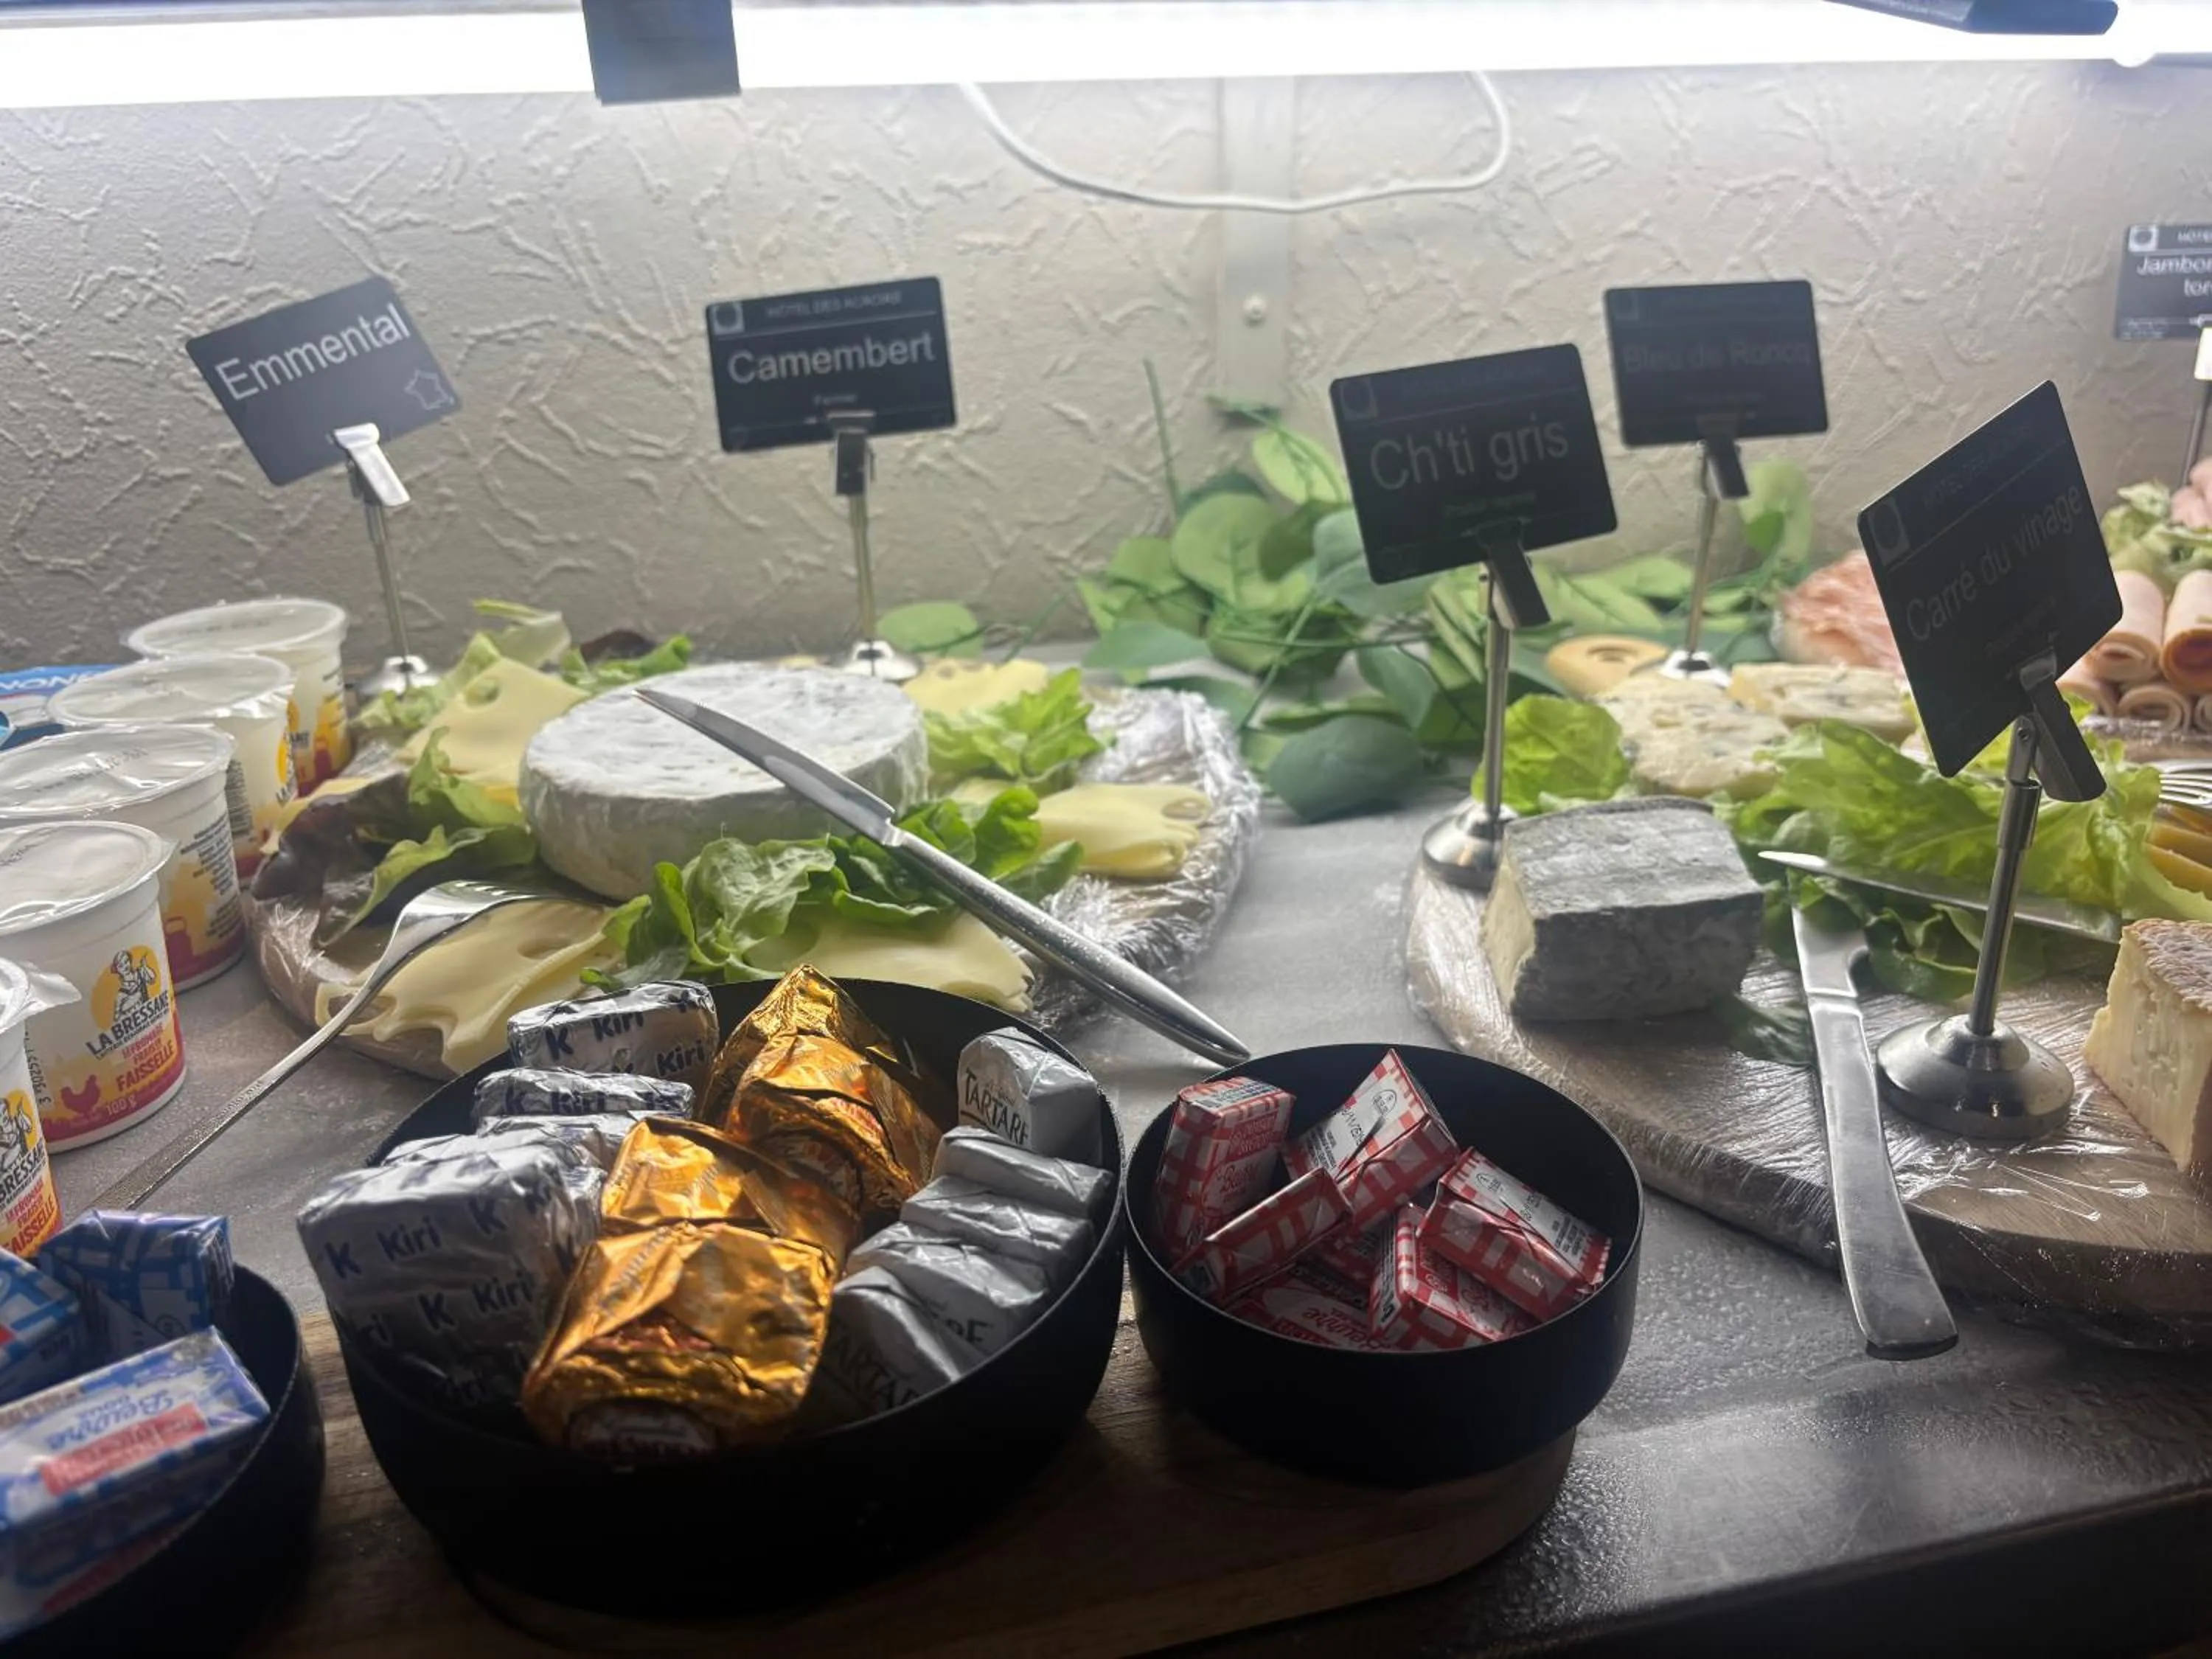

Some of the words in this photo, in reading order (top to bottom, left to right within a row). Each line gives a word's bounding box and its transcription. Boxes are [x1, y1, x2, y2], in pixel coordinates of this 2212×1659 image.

[215, 302, 411, 400] Emmental
[728, 332, 936, 384] Camembert
[1370, 422, 1475, 490] Ch'ti
[1489, 412, 1570, 481] gris
[1905, 560, 1979, 642] Carré
[1981, 542, 2012, 586] du
[2014, 484, 2084, 559] vinage
[86, 1033, 112, 1054] LA
[591, 1011, 644, 1041] Kiri
[116, 1040, 173, 1092] FAISSELLE
[656, 1040, 705, 1077] Kiri
[106, 1097, 128, 1116] 100
[377, 1216, 442, 1260] Kiri
[472, 1272, 532, 1313] Kiri
